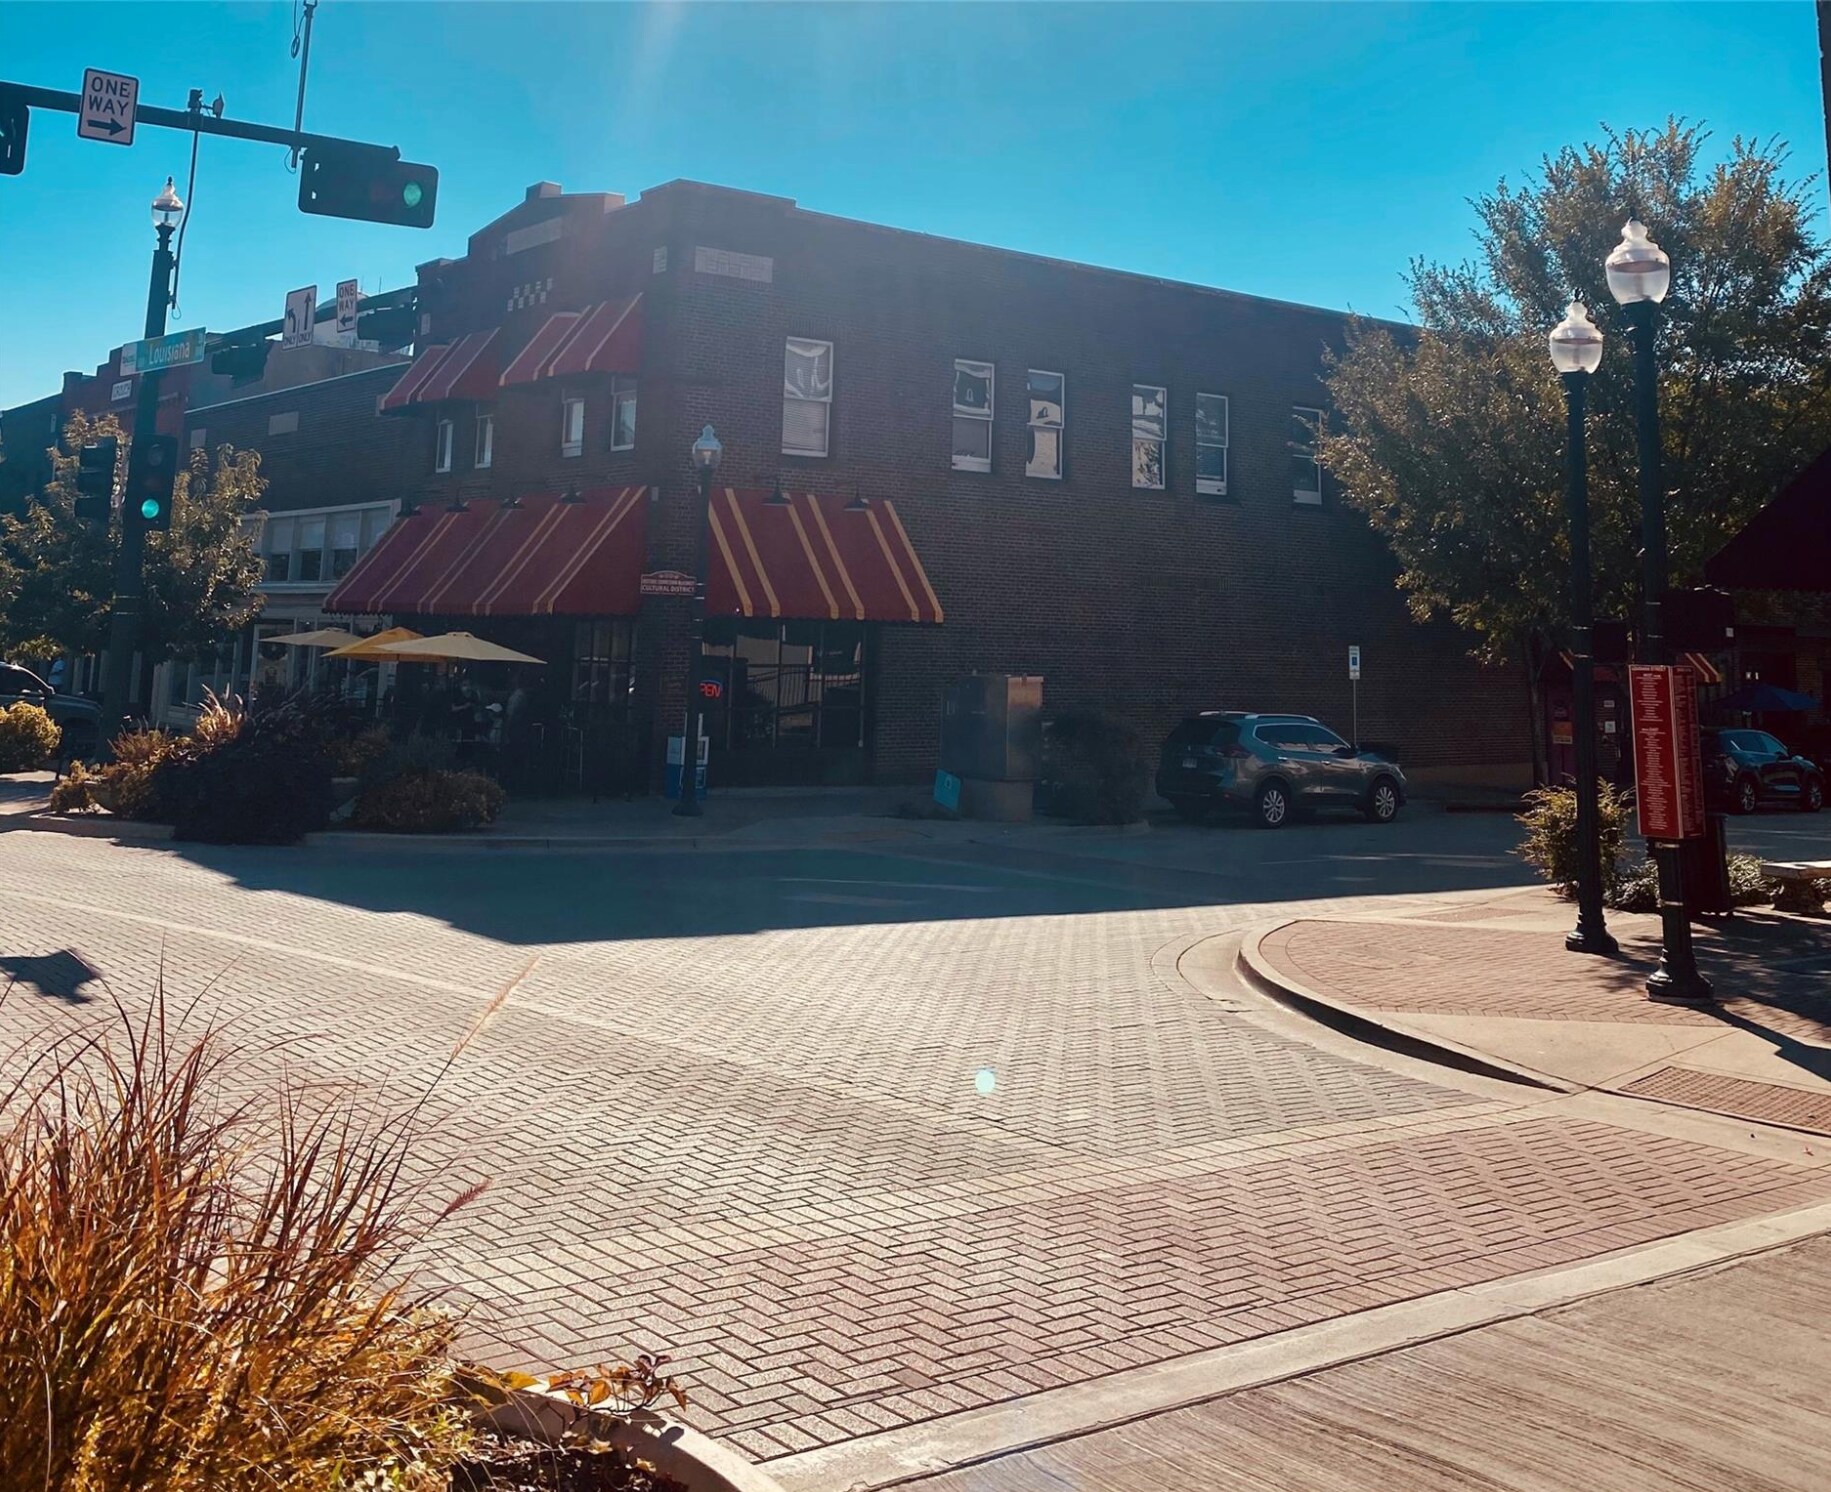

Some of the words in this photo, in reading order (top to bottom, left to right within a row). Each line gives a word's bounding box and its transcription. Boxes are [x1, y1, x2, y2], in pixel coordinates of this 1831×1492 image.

[91, 76, 130, 99] ONE
[89, 94, 129, 117] WAY
[339, 283, 355, 298] ONE
[338, 299, 354, 313] WAY
[148, 341, 190, 365] Louisiana
[699, 683, 720, 697] PEN
